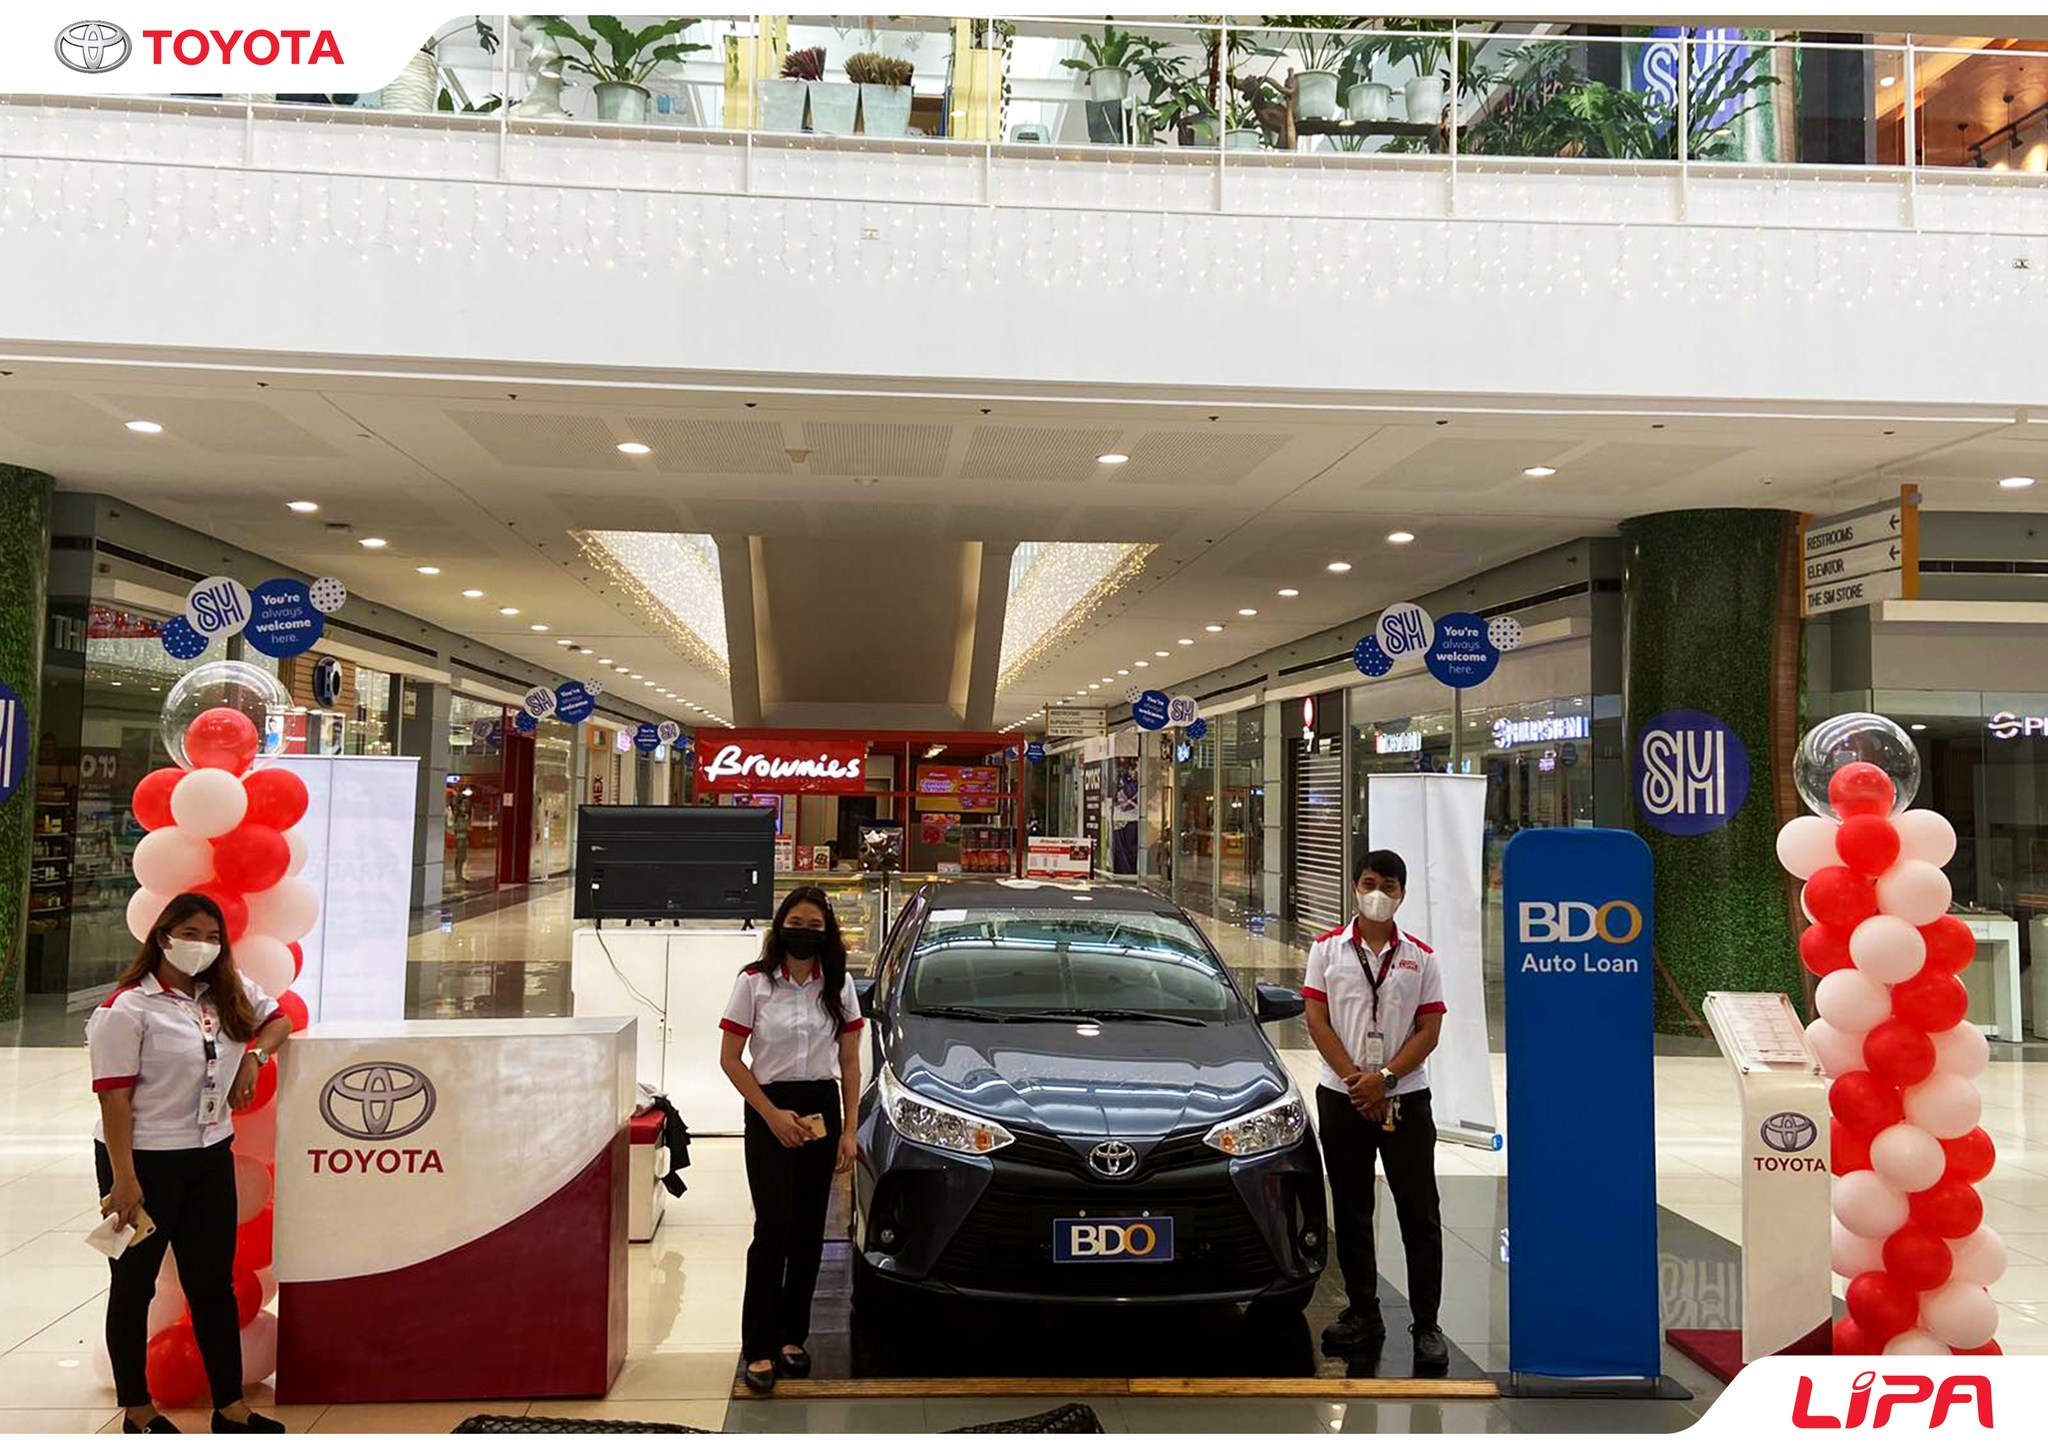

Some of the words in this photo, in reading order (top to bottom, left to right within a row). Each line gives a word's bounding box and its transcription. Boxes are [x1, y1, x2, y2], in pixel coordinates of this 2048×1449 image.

[1806, 526, 1854, 551] RESTROOMS
[1807, 558, 1845, 579] ELEVATOR
[261, 592, 301, 606] You're
[1807, 591, 1822, 608] THE
[1823, 588, 1836, 605] SM
[1836, 583, 1863, 603] STORE
[191, 581, 246, 633] SM
[261, 607, 304, 620] always
[255, 618, 312, 633] welcome
[1382, 608, 1428, 655] SM
[1444, 626, 1479, 637] You're
[271, 632, 300, 644] here.
[1436, 651, 1487, 662] welcome
[1449, 663, 1475, 675] here.
[704, 745, 860, 782] Brownies
[1642, 729, 1726, 816] SM
[1518, 899, 1643, 945] BDO
[1521, 952, 1577, 974] Auto
[1583, 952, 1639, 974] Loan
[307, 1148, 444, 1174] TOYOTA
[1753, 1156, 1827, 1173] TOYOTA
[1070, 1222, 1157, 1257] BDO
